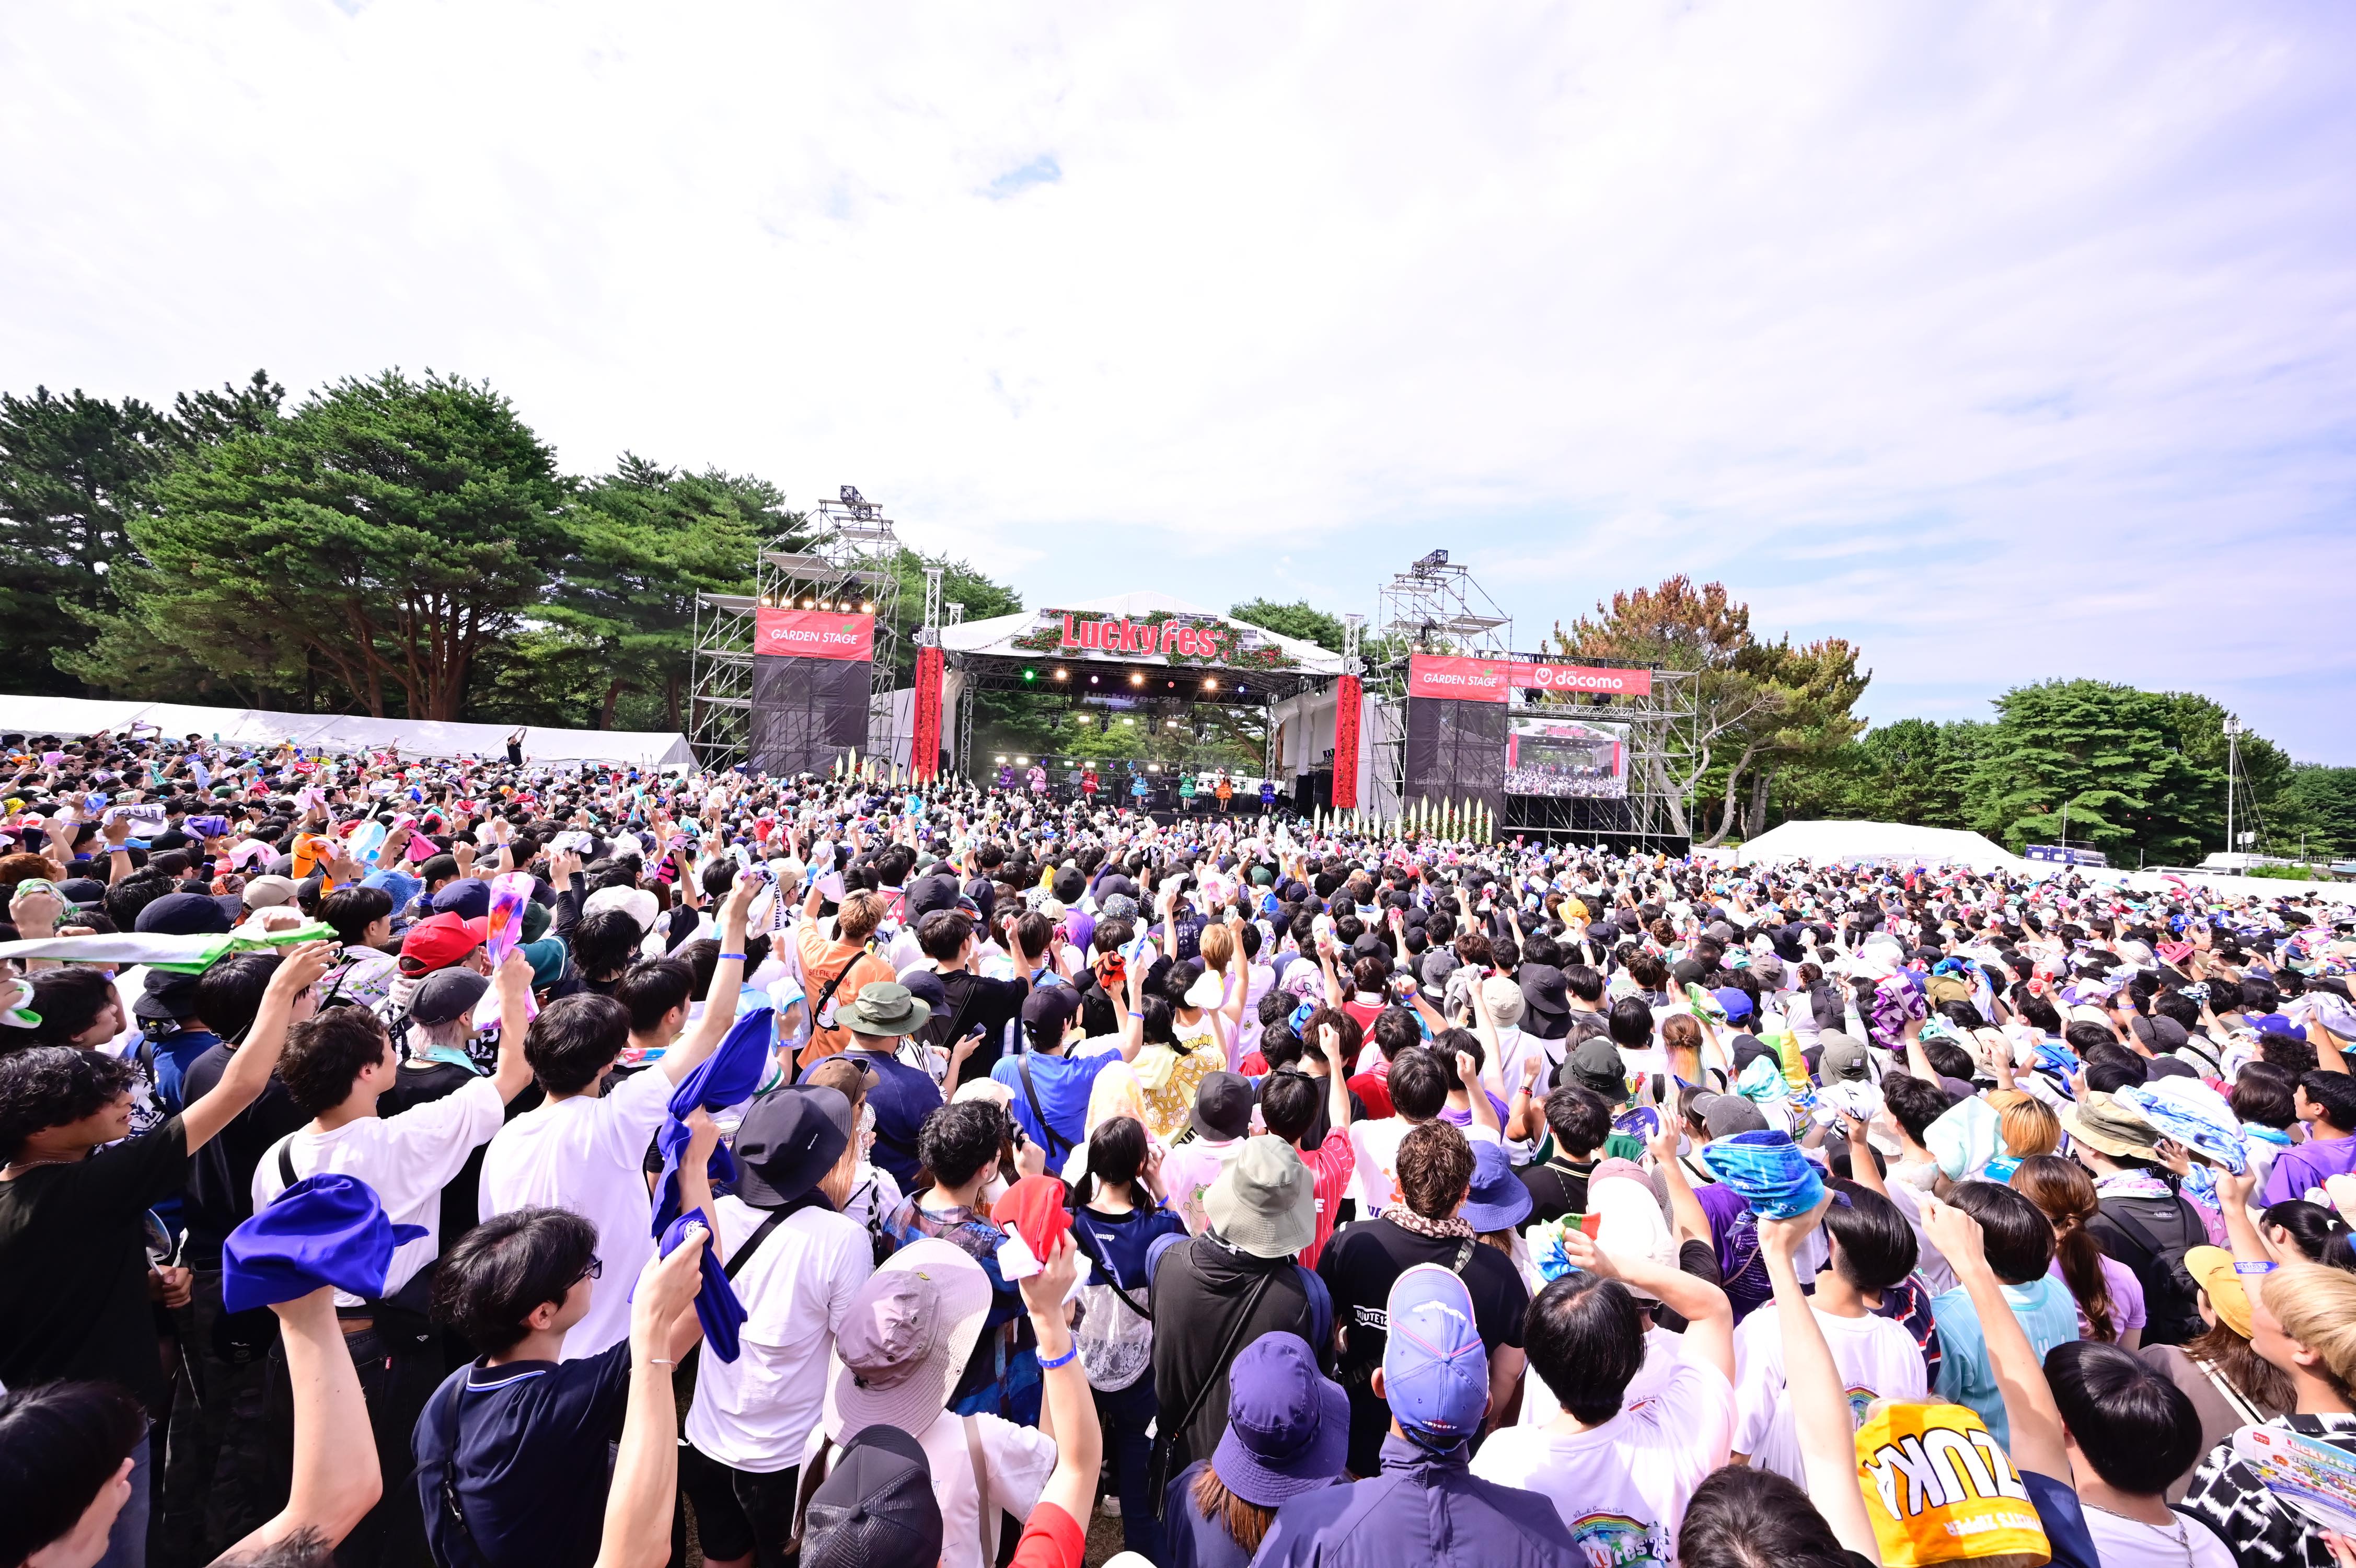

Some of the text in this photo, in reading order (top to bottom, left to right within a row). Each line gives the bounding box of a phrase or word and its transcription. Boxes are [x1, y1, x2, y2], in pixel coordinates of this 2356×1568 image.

[771, 629, 858, 644] GARDEN STAGE
[1423, 673, 1496, 687] GARDEN STAGE
[1555, 671, 1623, 689] docomo
[760, 743, 795, 753] LuckyFes
[1415, 777, 1446, 787] LuckyFes
[808, 969, 830, 977] SELFIE
[1095, 1233, 1115, 1242] anap
[1422, 1420, 1458, 1429] ODYSSEY
[1573, 1508, 1592, 1519] Hitachi
[1943, 1517, 1999, 1536] ZIPPER
